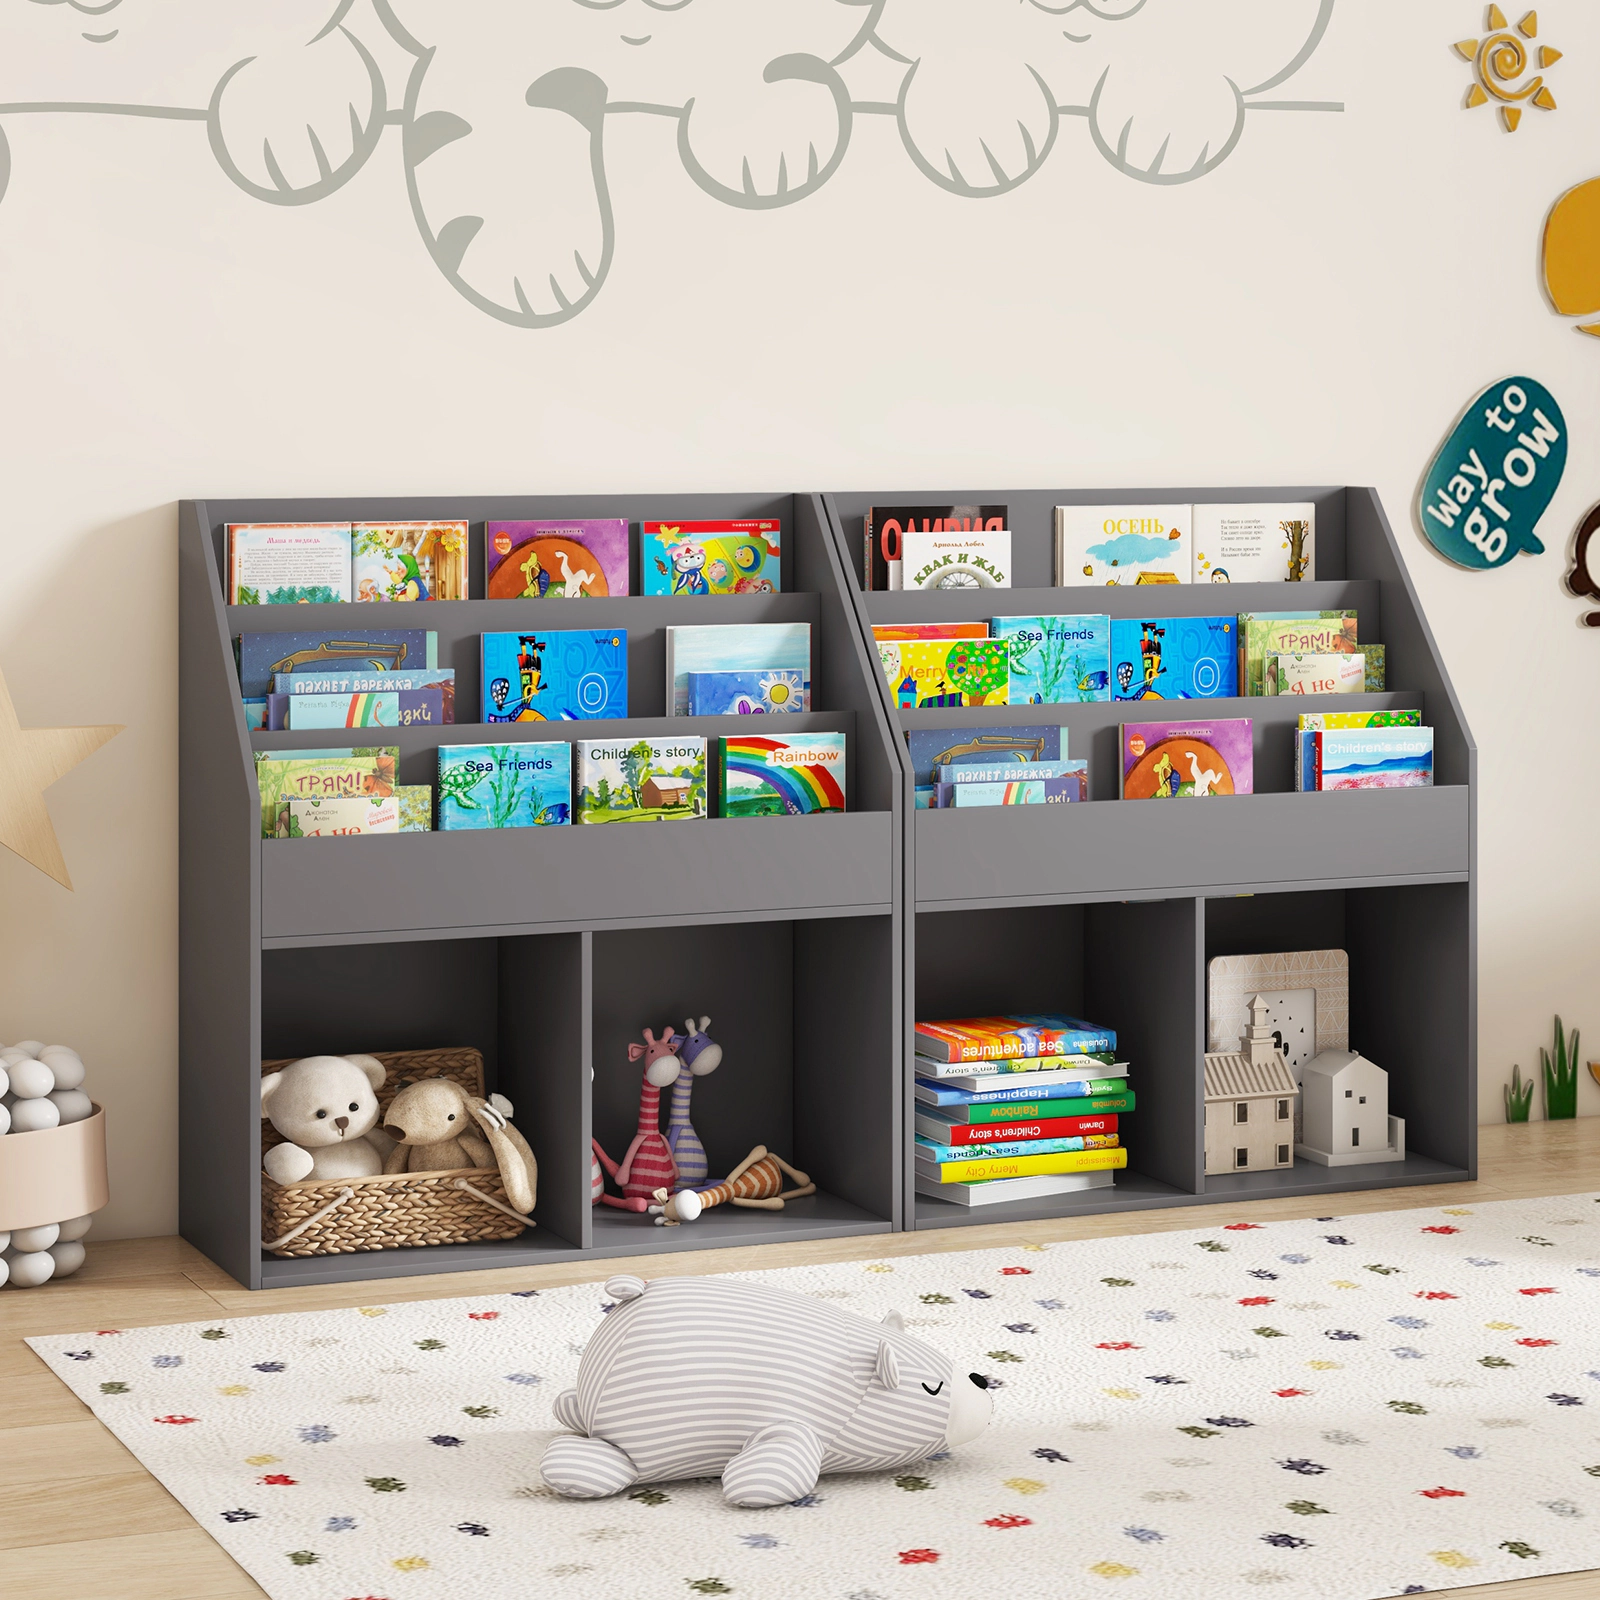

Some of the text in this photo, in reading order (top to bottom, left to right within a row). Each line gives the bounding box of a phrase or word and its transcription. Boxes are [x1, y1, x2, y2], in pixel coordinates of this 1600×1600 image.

[1427, 385, 1527, 528] way to
[1463, 407, 1560, 562] grow
[1103, 518, 1164, 535] ОСЕНЬ
[933, 541, 962, 549] Арнольд
[913, 553, 953, 586] КВАК
[957, 553, 969, 563] И
[971, 555, 1005, 583] ЖАБ
[1017, 628, 1094, 641] Sea Friends
[1278, 631, 1330, 649] ТРЯМ!
[900, 665, 947, 680] Merry
[1312, 679, 1335, 693] не
[590, 746, 700, 761] Children's story
[773, 749, 839, 763] Rainbow
[1327, 741, 1427, 755] Children's story
[465, 757, 553, 773] Sea Friends
[296, 771, 361, 793] ТРЯМ!
[962, 1039, 1108, 1058] Louisiana Sea adventures
[945, 1067, 970, 1077] story
[972, 1089, 1049, 1102] Happiness
[990, 1098, 1127, 1117] Columbia Rainbow
[969, 1121, 1104, 1139] Darwin Children's story
[995, 1147, 1019, 1156] Sea
[965, 1156, 1120, 1177] Mississippi Merry City
